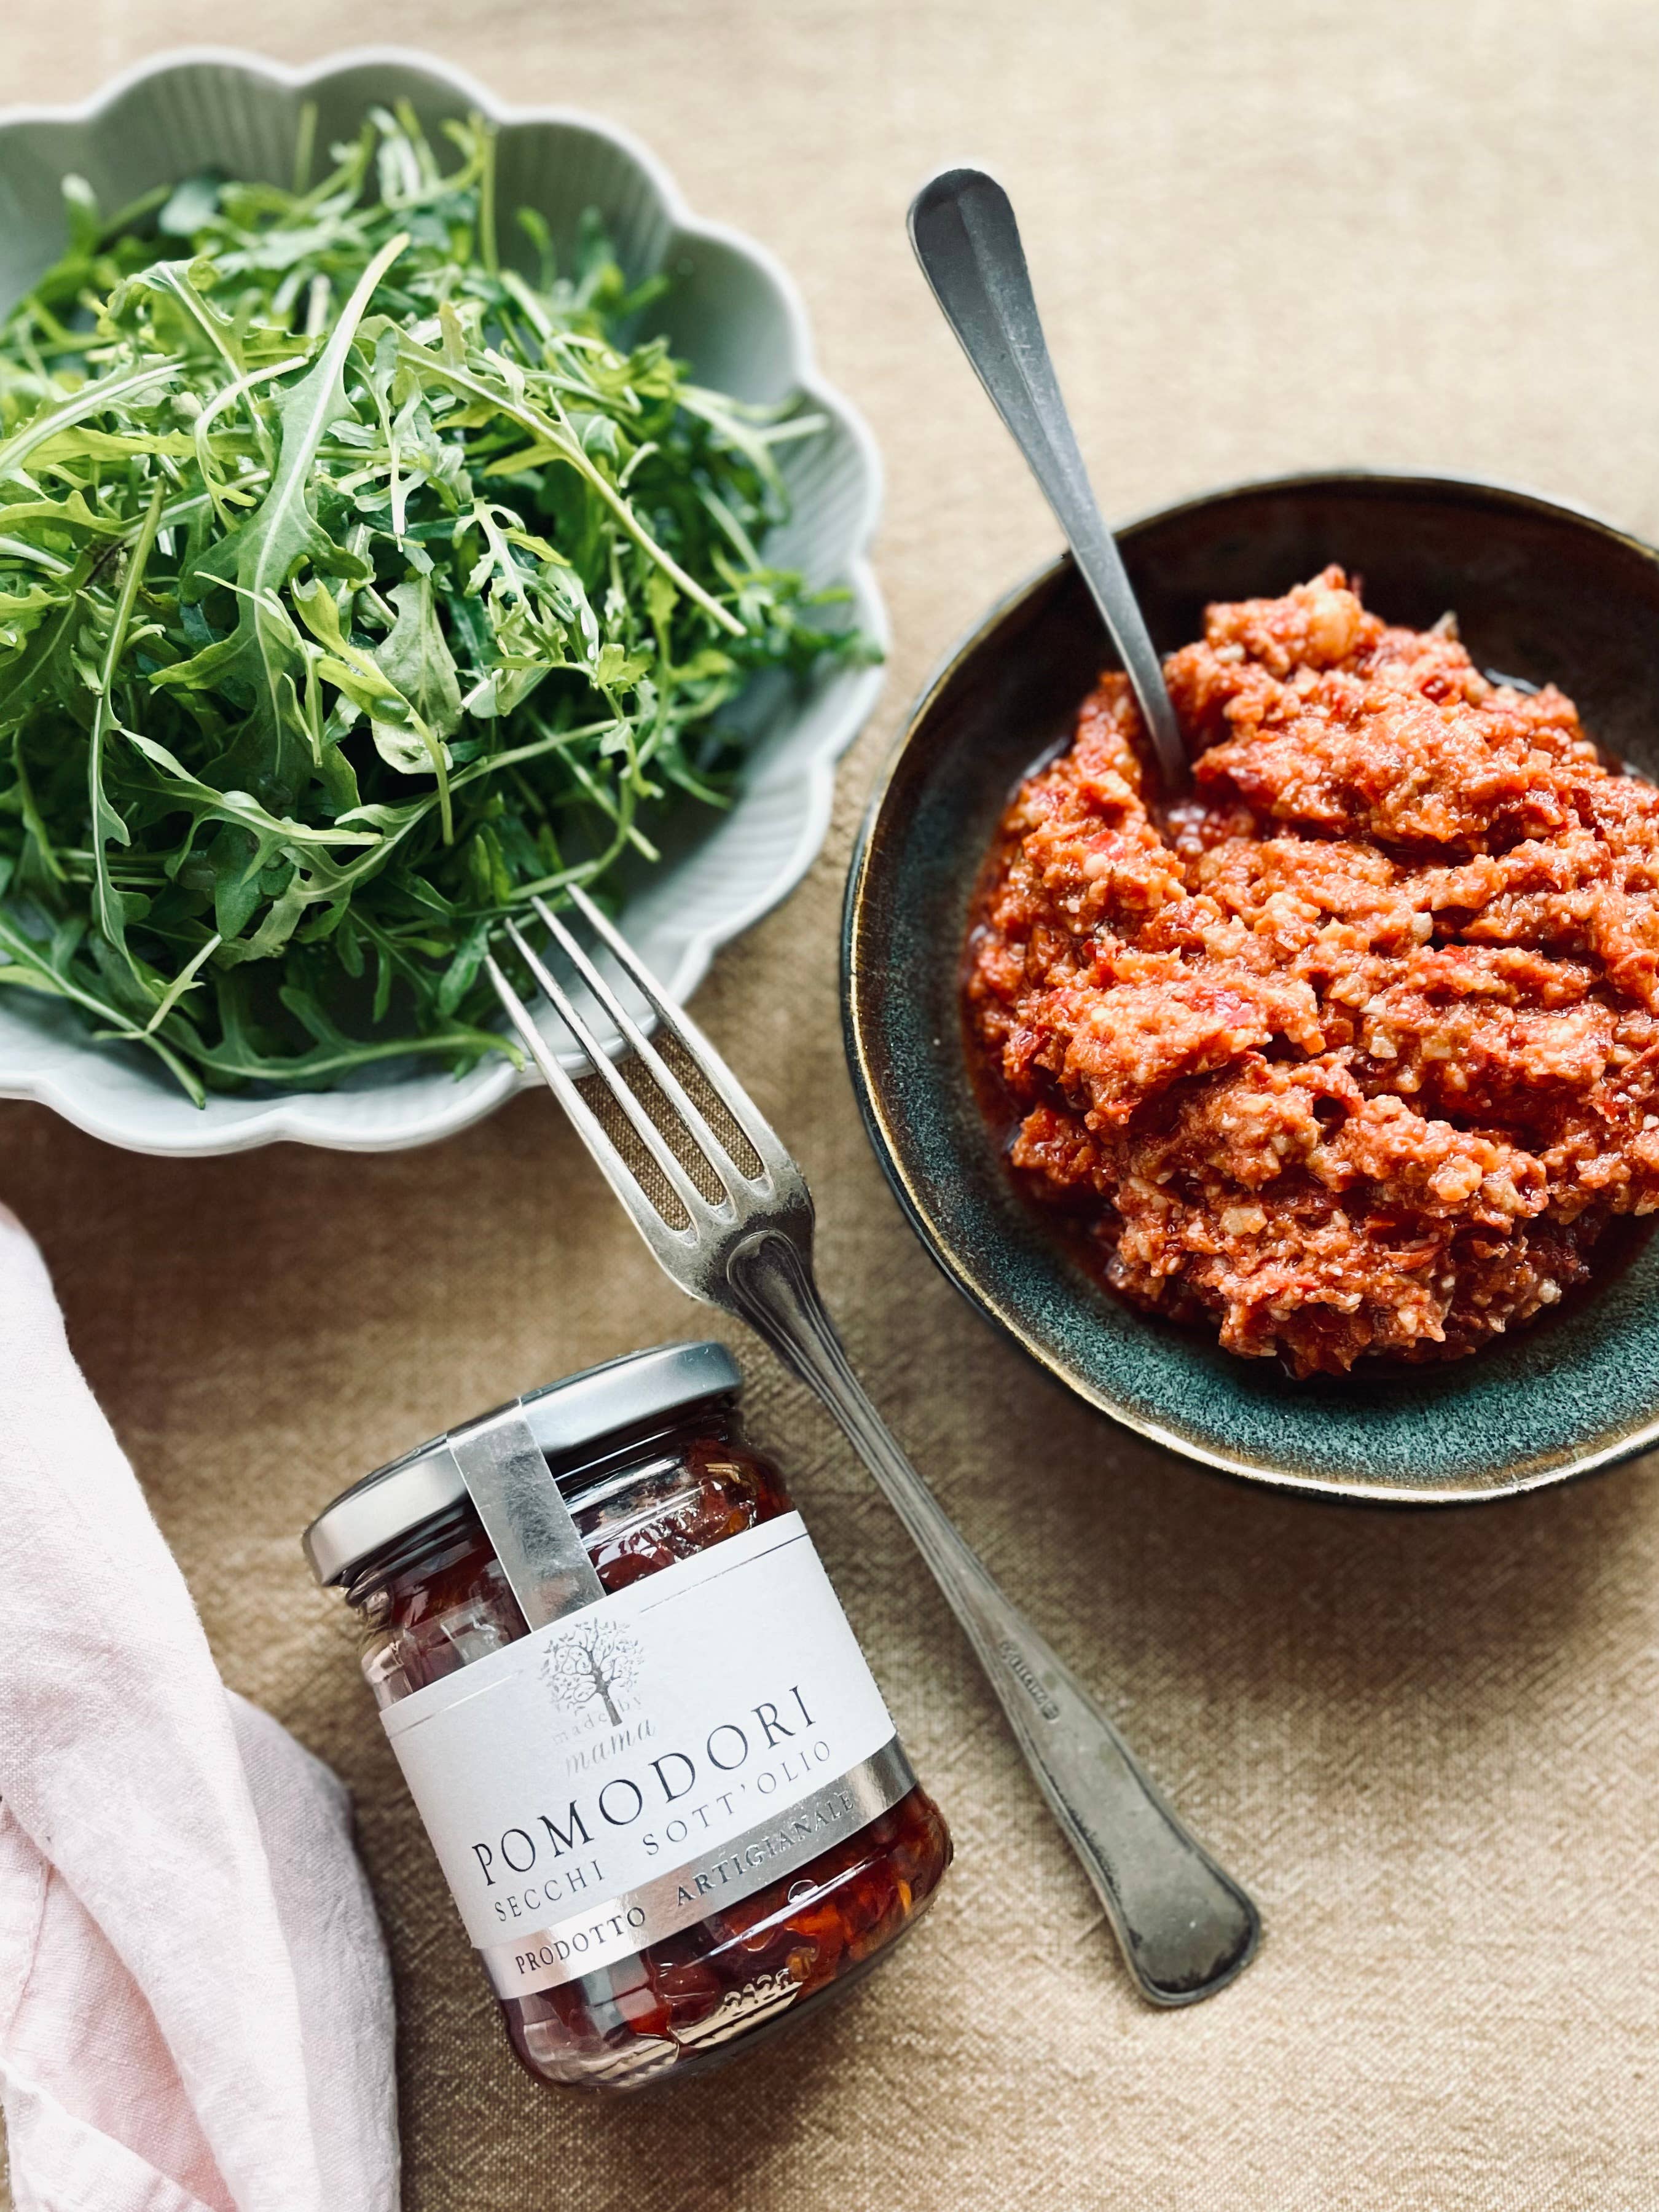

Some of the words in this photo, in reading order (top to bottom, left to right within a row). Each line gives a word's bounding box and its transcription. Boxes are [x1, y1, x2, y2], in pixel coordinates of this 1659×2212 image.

[471, 1685, 817, 1886] POMODORI
[494, 1859, 605, 1922] SECCHI
[642, 1741, 830, 1856] SOTT'OLIO
[565, 1719, 656, 1778] mama
[514, 1907, 646, 1975] PRODOTTO
[677, 1788, 854, 1907] ARTIGIANALE
